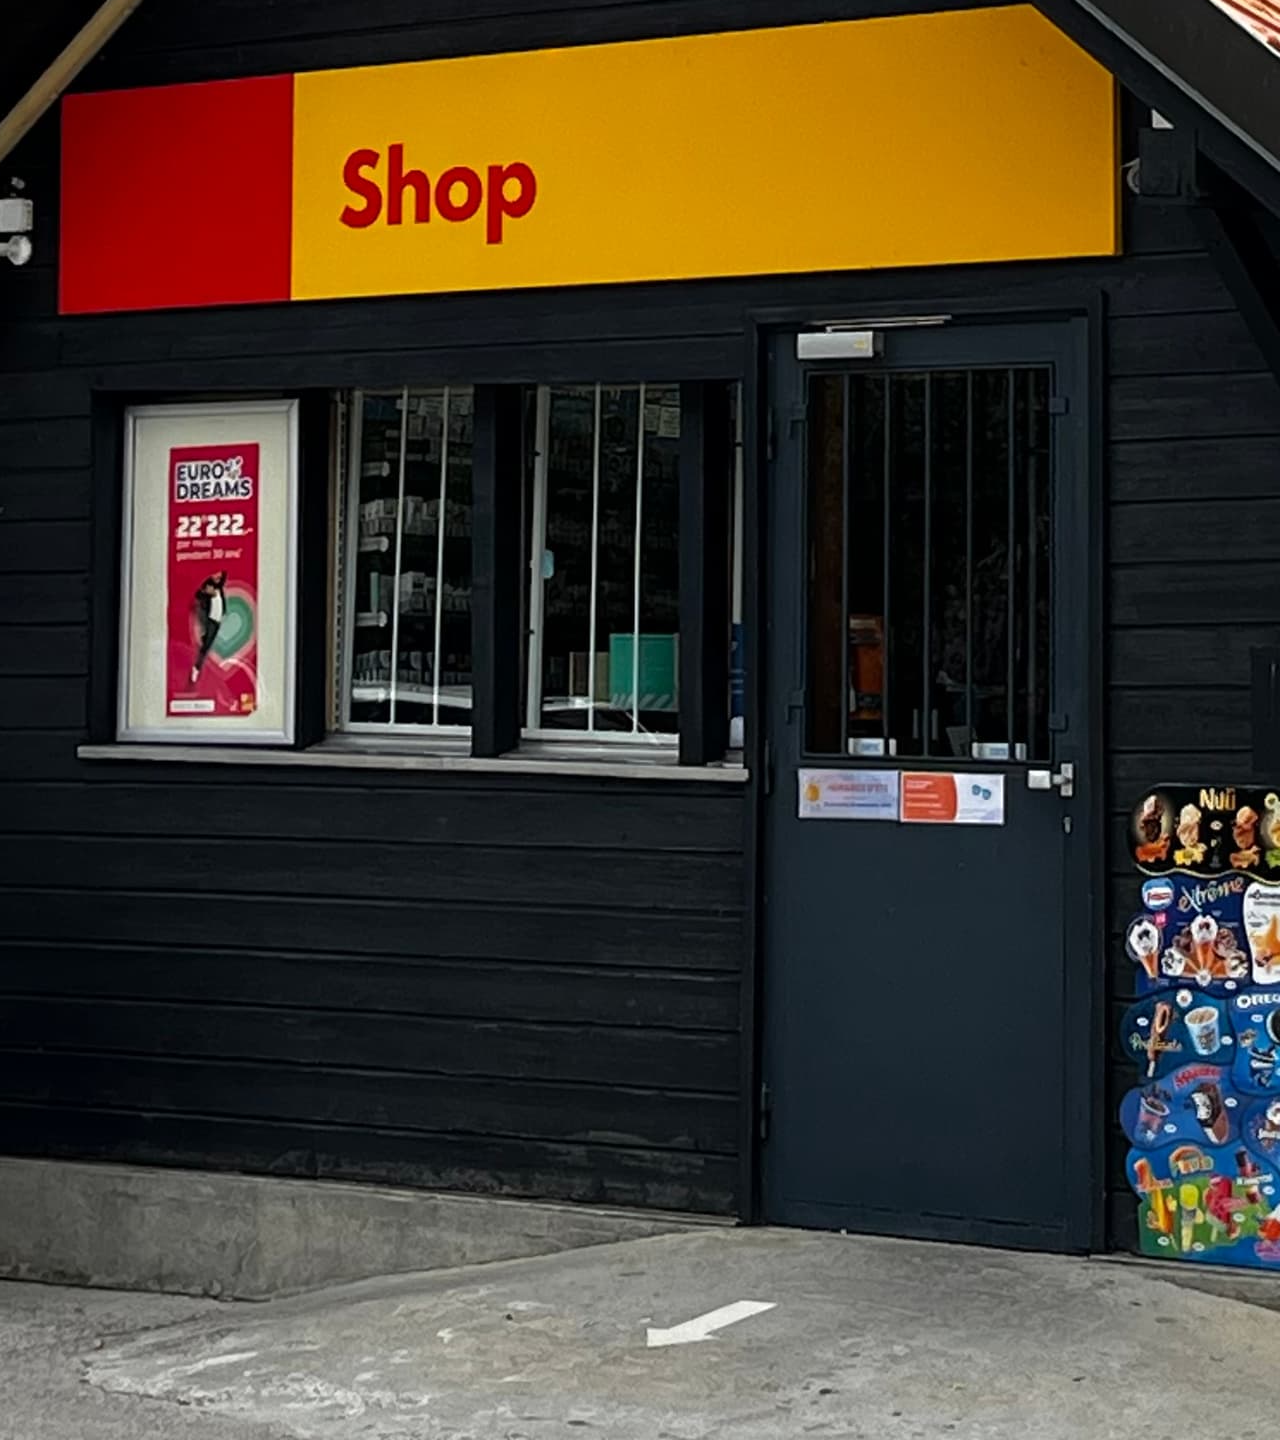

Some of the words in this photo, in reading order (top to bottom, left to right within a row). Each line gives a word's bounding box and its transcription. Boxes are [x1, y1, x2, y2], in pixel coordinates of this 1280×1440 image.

[340, 143, 537, 245] Shop
[175, 462, 225, 481] EURO
[176, 479, 251, 500] DREAMS
